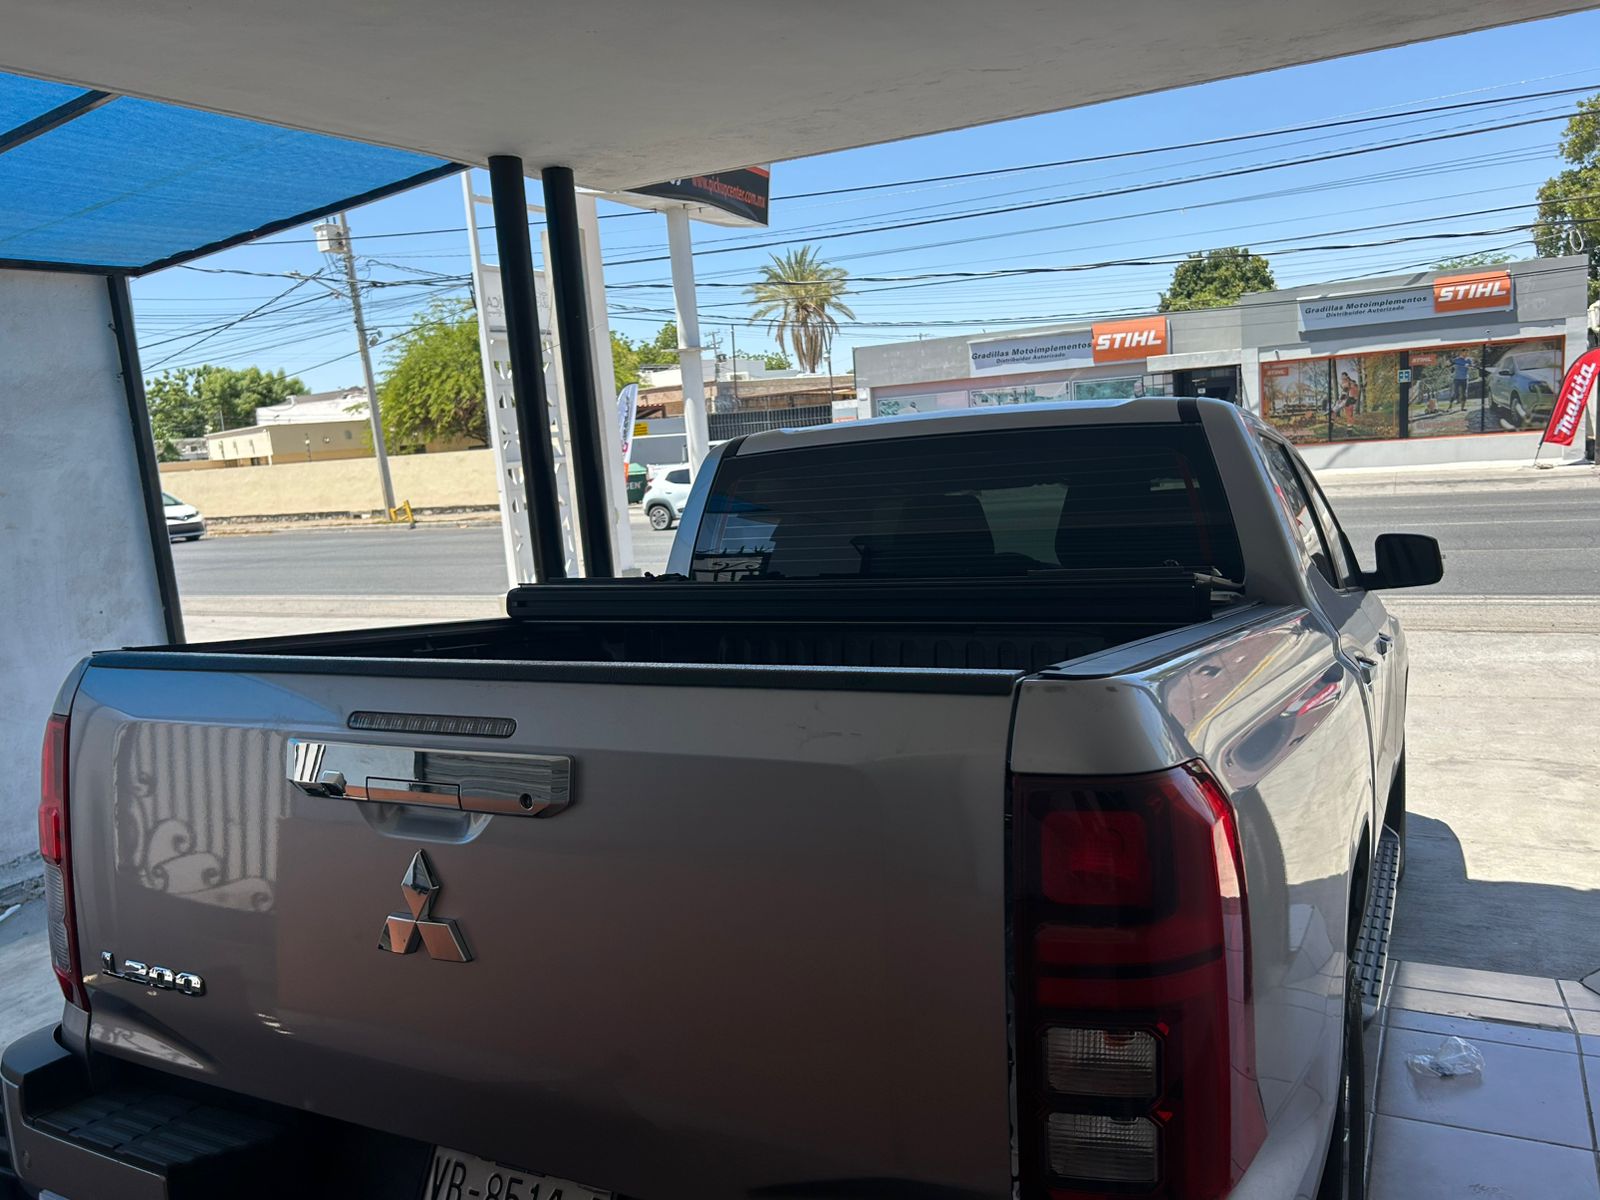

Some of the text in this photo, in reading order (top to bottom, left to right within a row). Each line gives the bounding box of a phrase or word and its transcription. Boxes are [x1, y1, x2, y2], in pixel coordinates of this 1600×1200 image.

[1437, 281, 1507, 302] STIHL
[1304, 295, 1428, 315] Gradillas Motoimplementos
[1325, 305, 1405, 319] Distribuidor Autorizado
[1095, 329, 1162, 351] STIHL
[971, 341, 1092, 361] Gradillas Motoimplementos
[101, 950, 207, 998] L200
